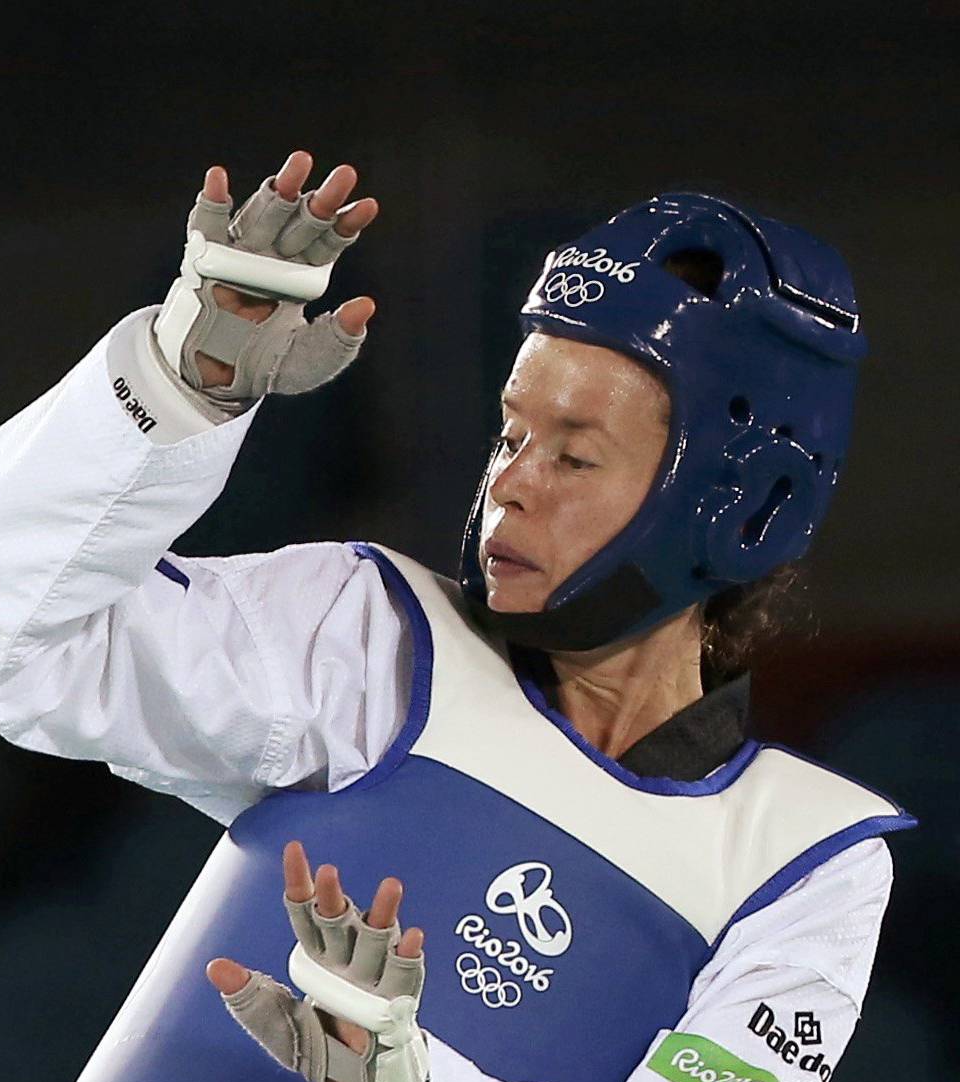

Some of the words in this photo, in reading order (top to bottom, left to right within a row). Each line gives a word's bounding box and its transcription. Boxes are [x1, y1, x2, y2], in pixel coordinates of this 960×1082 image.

[553, 246, 640, 283] Rio2016
[113, 377, 157, 434] Daedo
[455, 914, 555, 992] Rio2016
